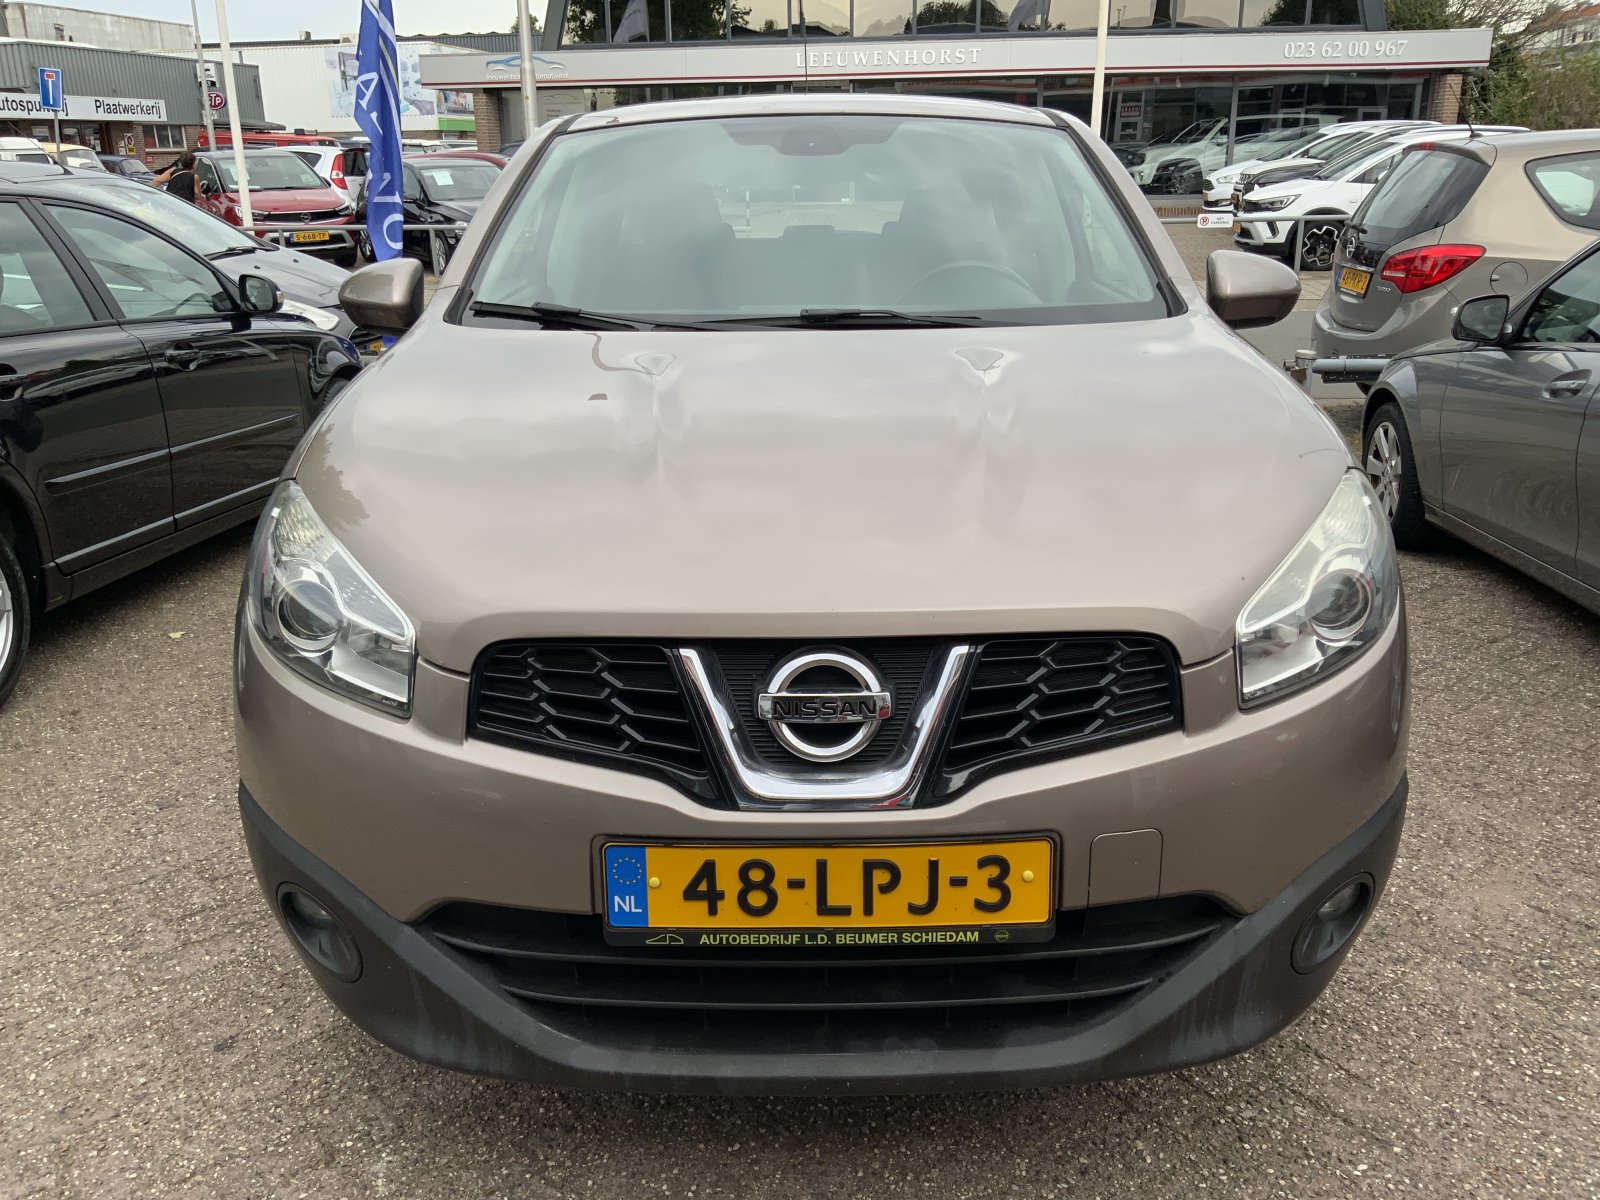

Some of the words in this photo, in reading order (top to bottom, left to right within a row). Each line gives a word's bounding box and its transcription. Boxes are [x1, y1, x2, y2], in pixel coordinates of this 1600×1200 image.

[795, 48, 981, 67] LEEUWENHORST
[1284, 41, 1316, 58] 023
[1321, 41, 1343, 57] 62
[1348, 40, 1370, 57] 00
[1375, 39, 1408, 57] 967
[95, 99, 161, 118] Plaatwerkerij
[772, 700, 878, 719] NISSAN
[683, 855, 1012, 917] 48-LPJ-3
[613, 895, 643, 913] NL
[699, 934, 801, 945] AUTOBEDRIJF
[804, 934, 832, 945] L.D.
[835, 933, 898, 945] BEUMER
[901, 931, 979, 944] SCHIEDAM
